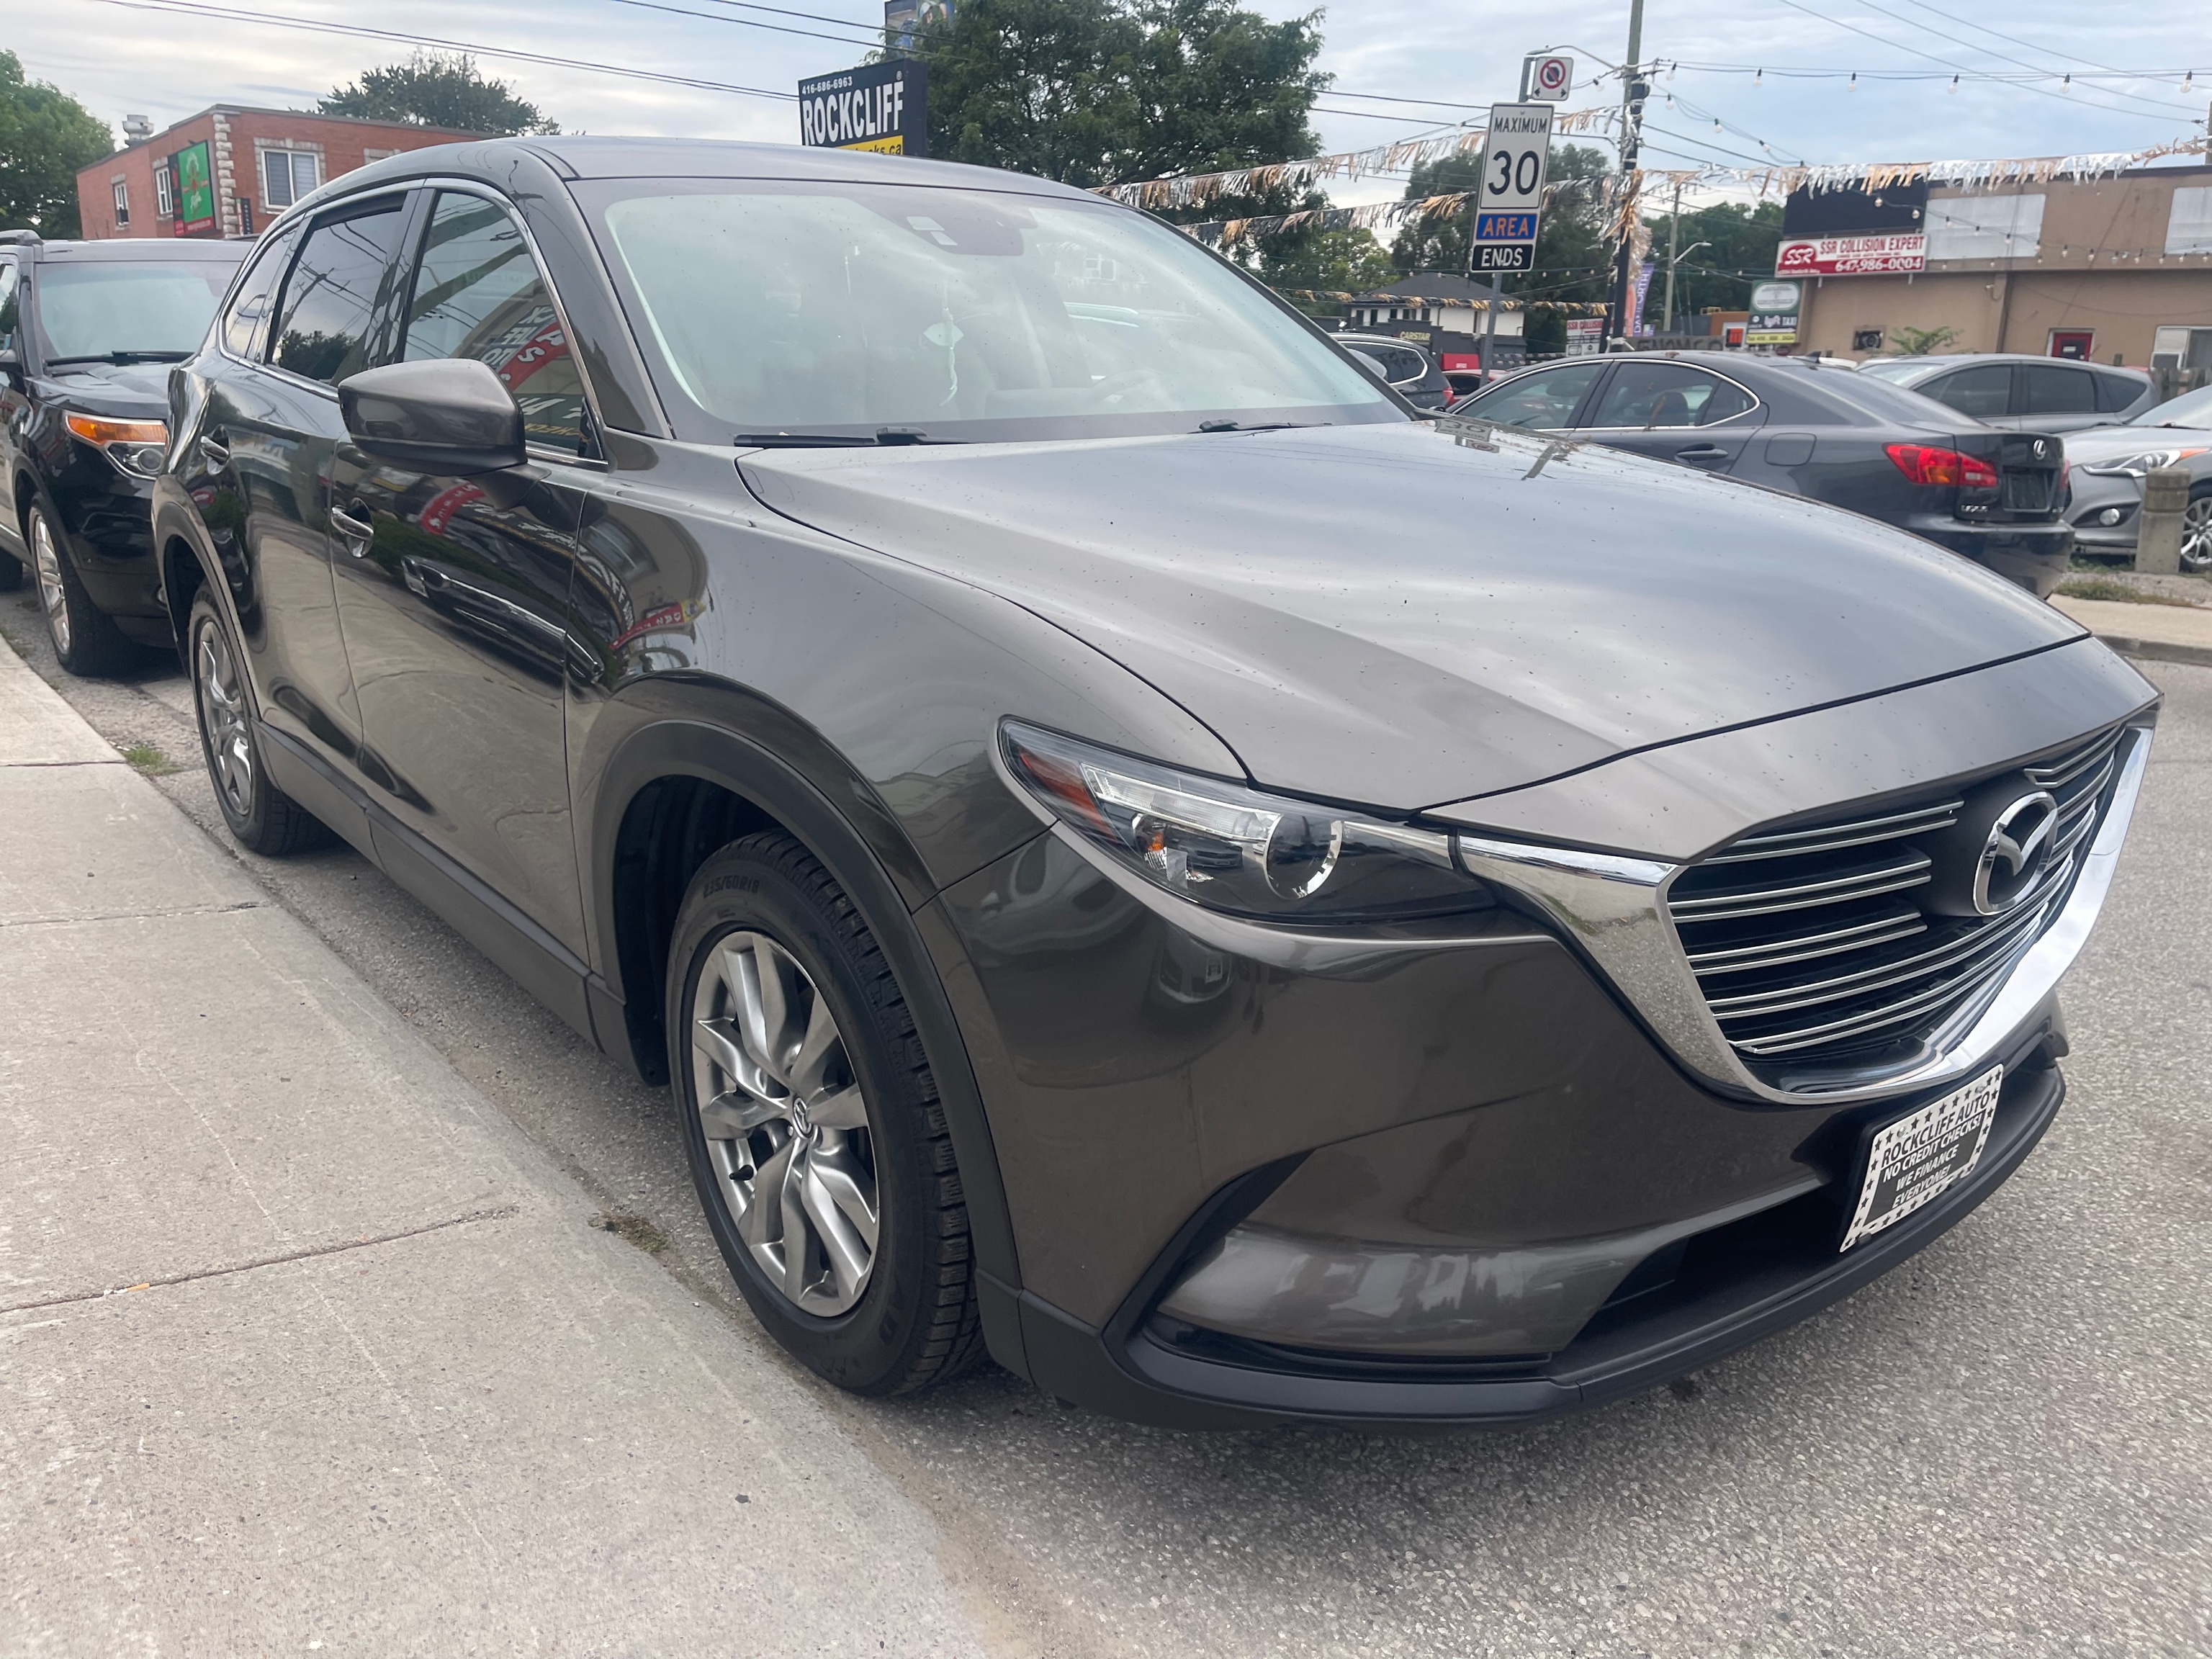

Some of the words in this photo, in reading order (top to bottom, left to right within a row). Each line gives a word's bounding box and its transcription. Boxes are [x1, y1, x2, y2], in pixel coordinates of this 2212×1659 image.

[802, 76, 853, 95] 416-686-6963
[802, 81, 904, 146] ROCKCLIFF
[1493, 117, 1547, 133] MAXIMUM
[1488, 150, 1539, 195] 30
[1482, 217, 1529, 236] AREA
[1820, 241, 1838, 255] SSR
[1840, 238, 1886, 253] COLLISION
[1889, 235, 1924, 251] EXPERT
[1480, 247, 1523, 267] ENDS
[1784, 247, 1814, 265] SSR
[1400, 331, 1431, 341] CARSTAR
[1881, 1112, 1956, 1168] ROCKCLIFF
[1955, 1091, 1990, 1125] AUTO
[1883, 1161, 1901, 1183] NO
[1902, 1138, 1941, 1172] CREDIT
[1941, 1114, 1981, 1149] CHECKS!
[1896, 1171, 1913, 1192] WE
[1913, 1143, 1959, 1182] FINANCE
[1892, 1164, 1951, 1209] EVERYONE!
